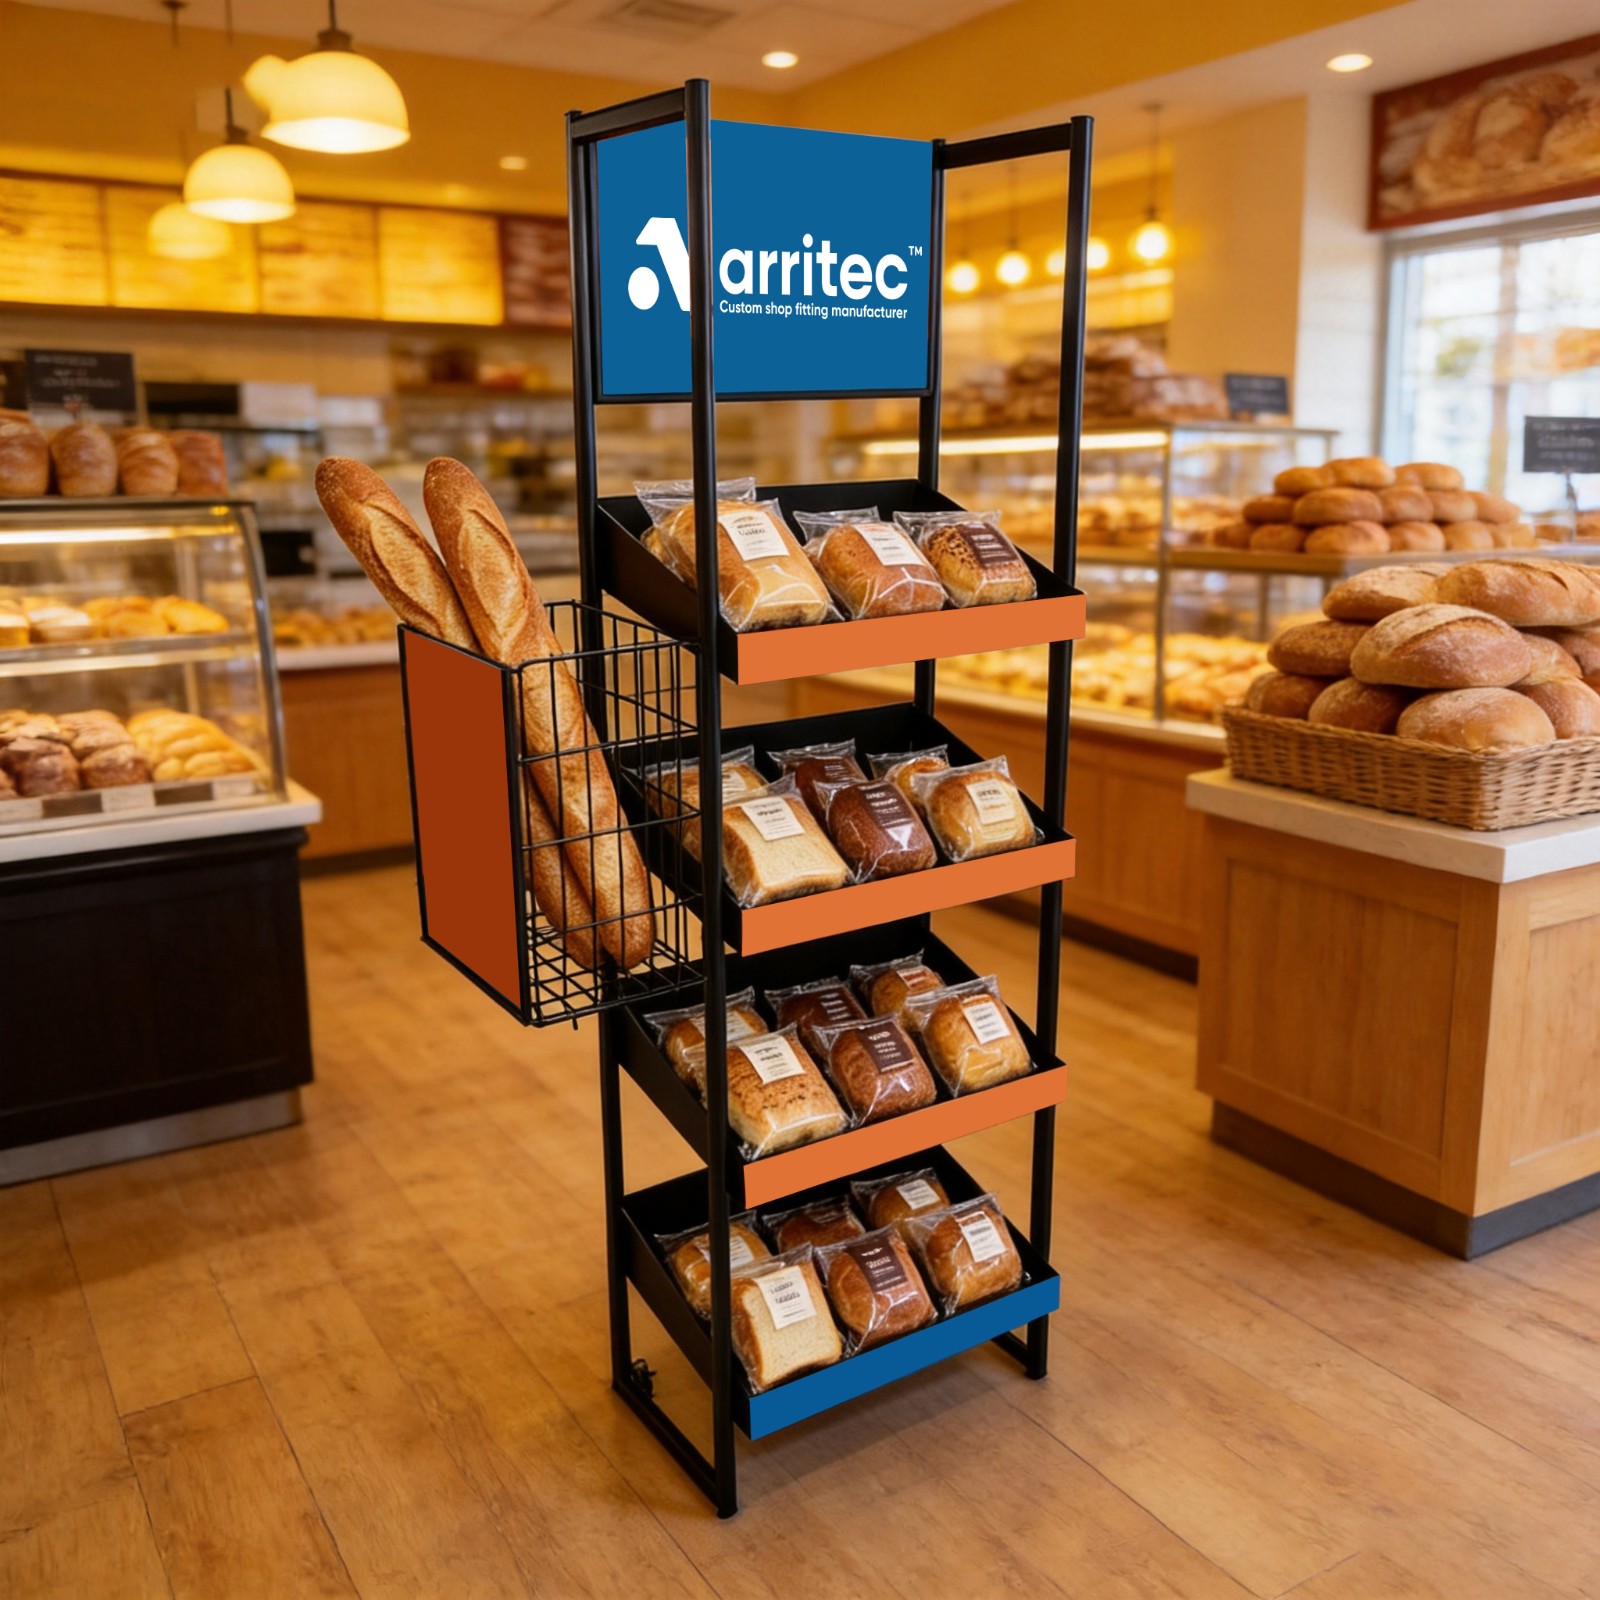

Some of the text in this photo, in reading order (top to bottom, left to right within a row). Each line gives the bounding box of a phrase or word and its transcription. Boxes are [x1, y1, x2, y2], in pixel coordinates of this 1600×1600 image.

[719, 300, 908, 319] Custom shop fitting manufacturer
